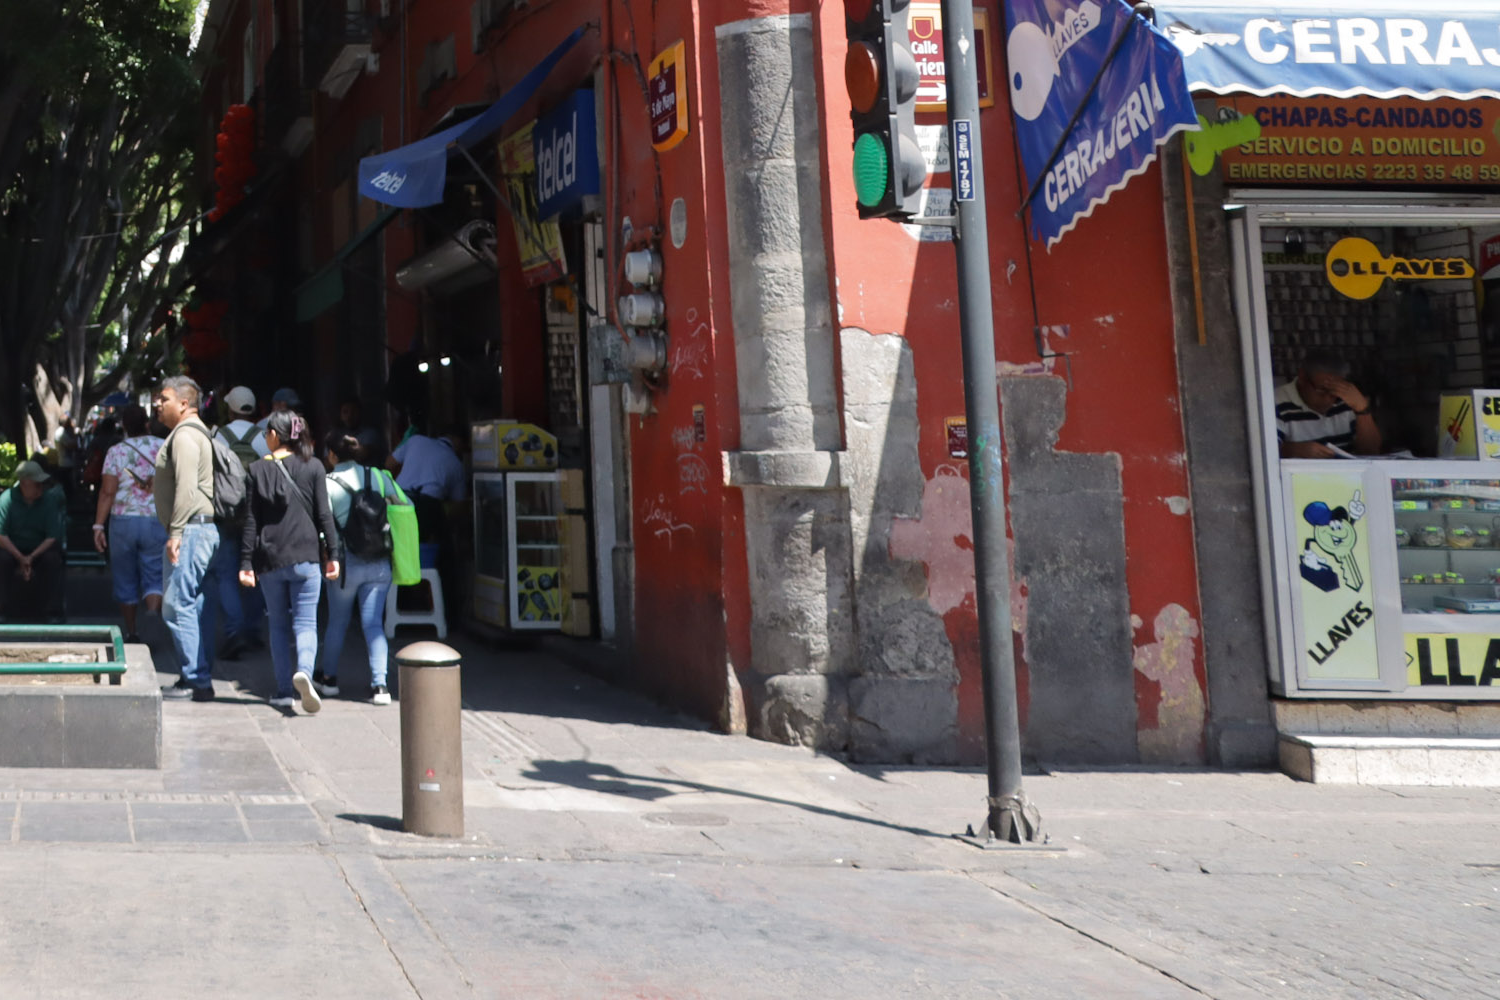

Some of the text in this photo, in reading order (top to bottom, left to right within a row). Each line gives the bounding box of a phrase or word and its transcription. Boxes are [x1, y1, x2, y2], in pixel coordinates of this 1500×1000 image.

[911, 41, 938, 54] Calle
[1052, 12, 1090, 60] LLAVES
[916, 58, 945, 76] rien
[1255, 106, 1483, 129] CHAPAS-CANDADOS
[1044, 73, 1165, 213] CERRAJERIA
[1240, 137, 1486, 157] SERVICIO A DOMICILIO
[538, 111, 577, 203] telcel
[958, 134, 970, 199] SEM 1787
[371, 170, 407, 194] telcel
[1229, 163, 1500, 182] EMERGENCIAS 2223 35 48 59
[1263, 252, 1324, 265] ERRAJE
[1352, 261, 1465, 275] LLAVES
[1307, 600, 1373, 665] LLAVES
